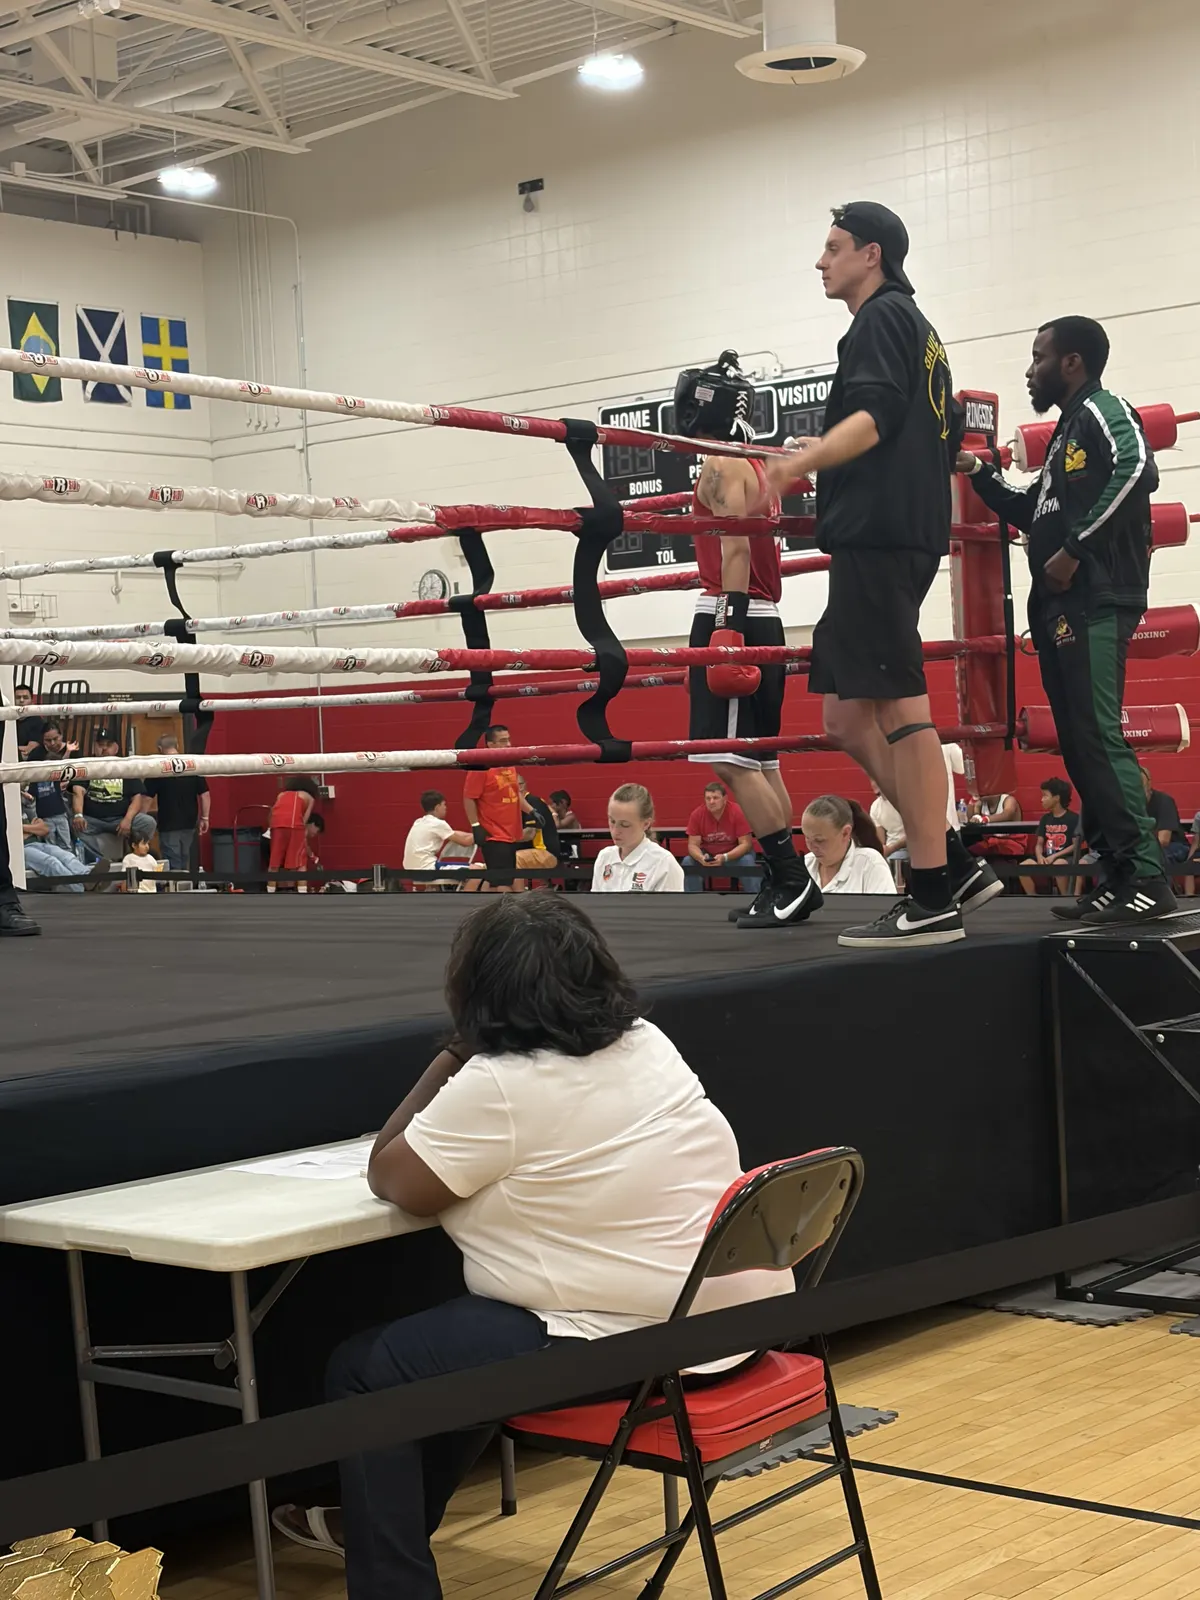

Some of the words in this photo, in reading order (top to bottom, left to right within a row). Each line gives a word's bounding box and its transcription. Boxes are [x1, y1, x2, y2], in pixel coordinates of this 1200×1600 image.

[609, 409, 651, 429] HOME
[965, 401, 995, 431] RINGSIDE
[629, 479, 663, 495] BONUS
[656, 549, 676, 564] TOL
